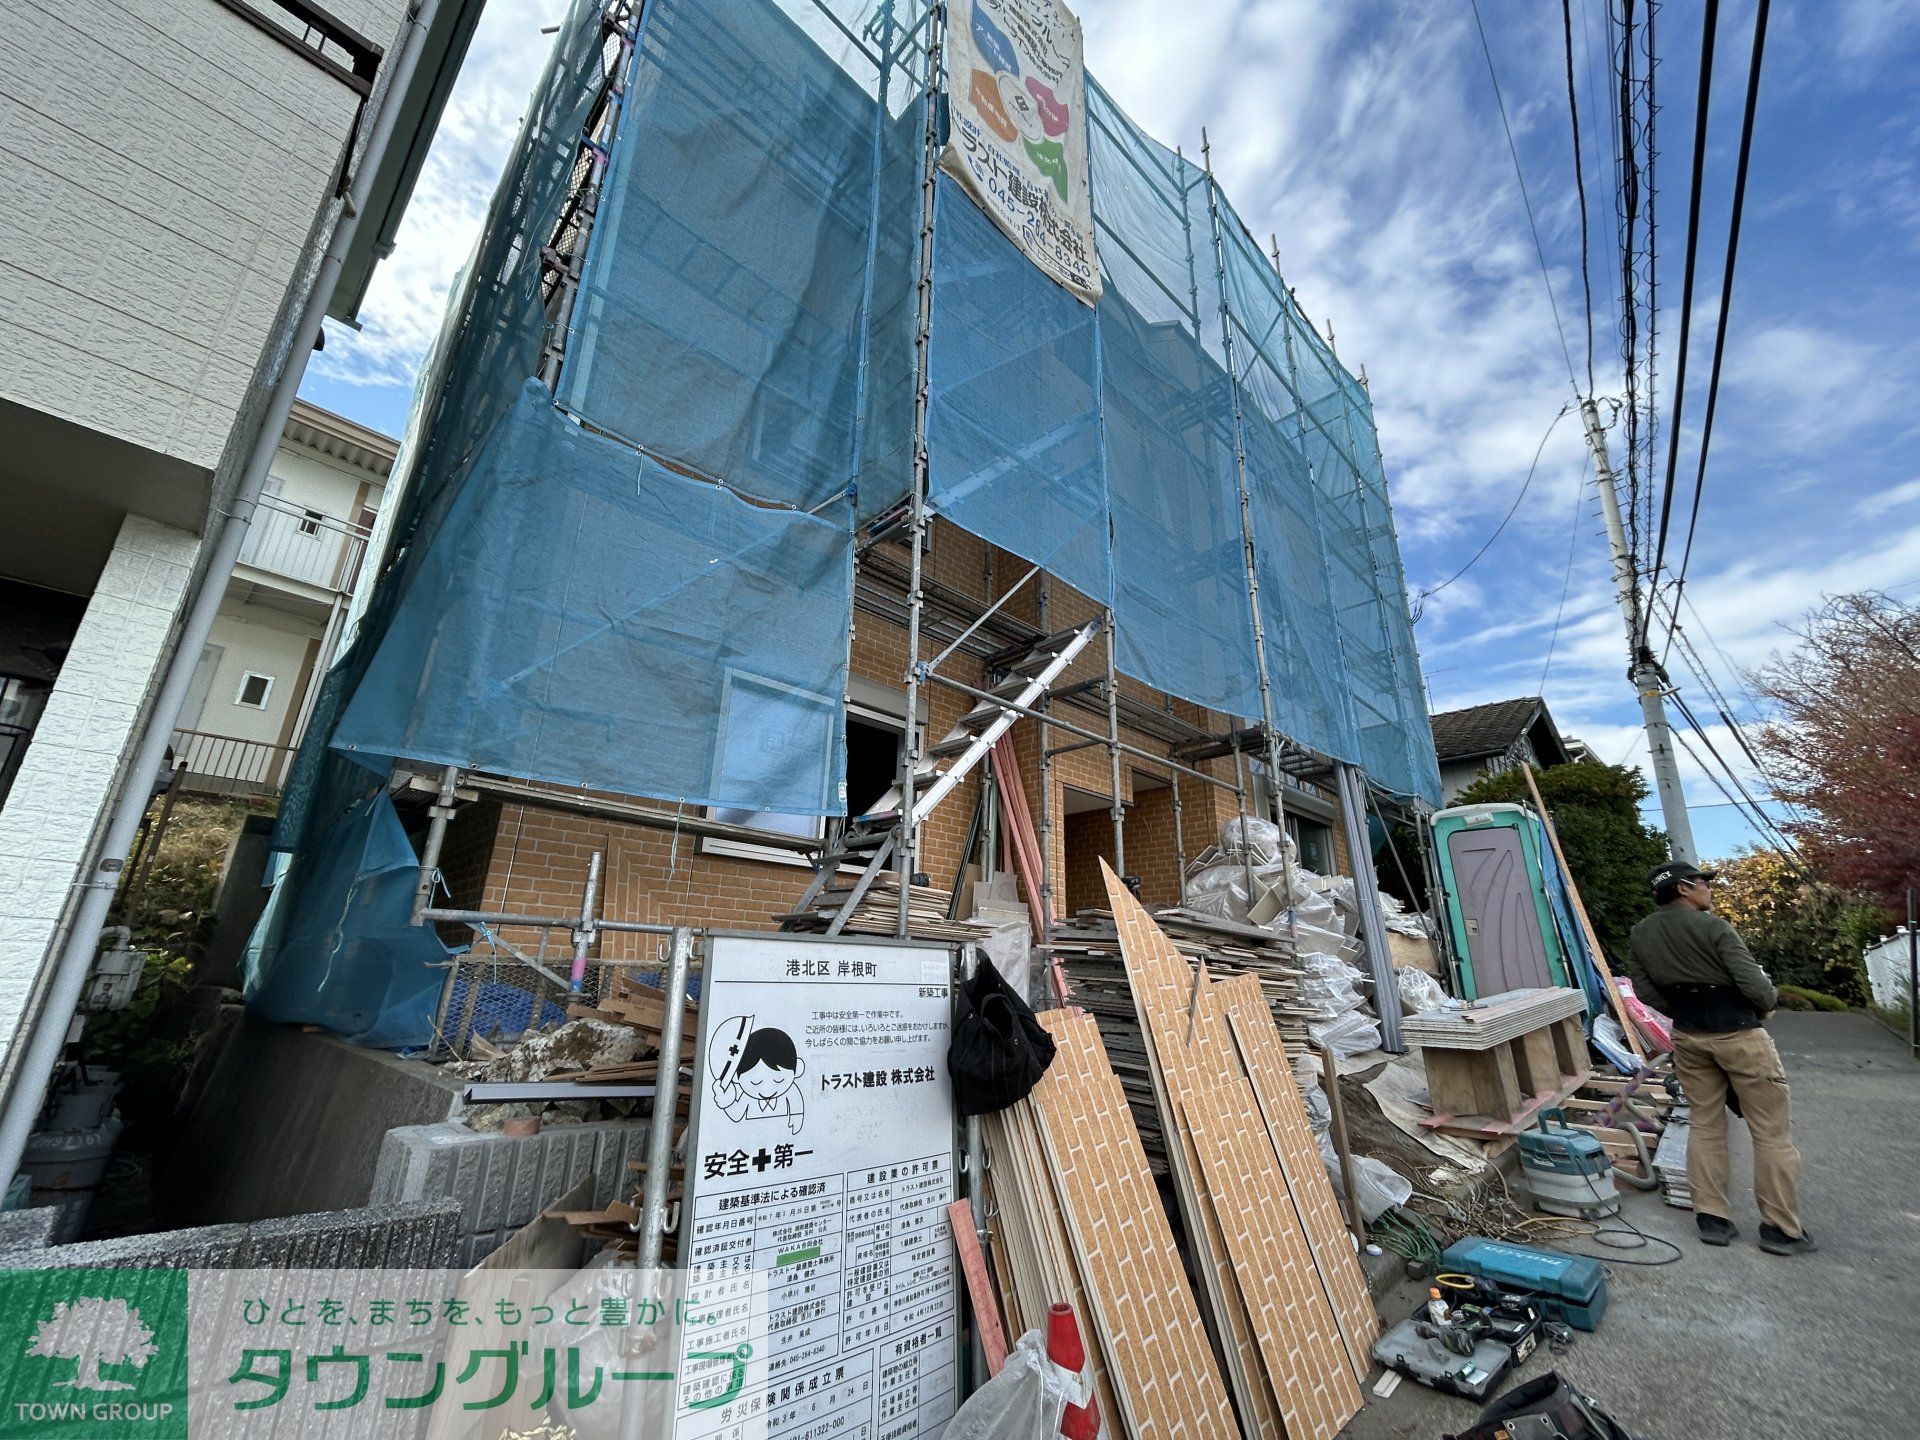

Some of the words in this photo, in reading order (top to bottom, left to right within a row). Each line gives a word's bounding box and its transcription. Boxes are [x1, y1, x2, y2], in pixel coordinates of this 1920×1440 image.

[786, 959, 830, 977] 港北区
[837, 960, 878, 977] 岸根町
[918, 987, 948, 998] 新築工事
[820, 1071, 888, 1091] トラスト建設
[890, 1065, 935, 1086] 株式会社
[866, 1159, 938, 1184] 建設業の許可票
[718, 1181, 826, 1212] 建築基準法による確認済
